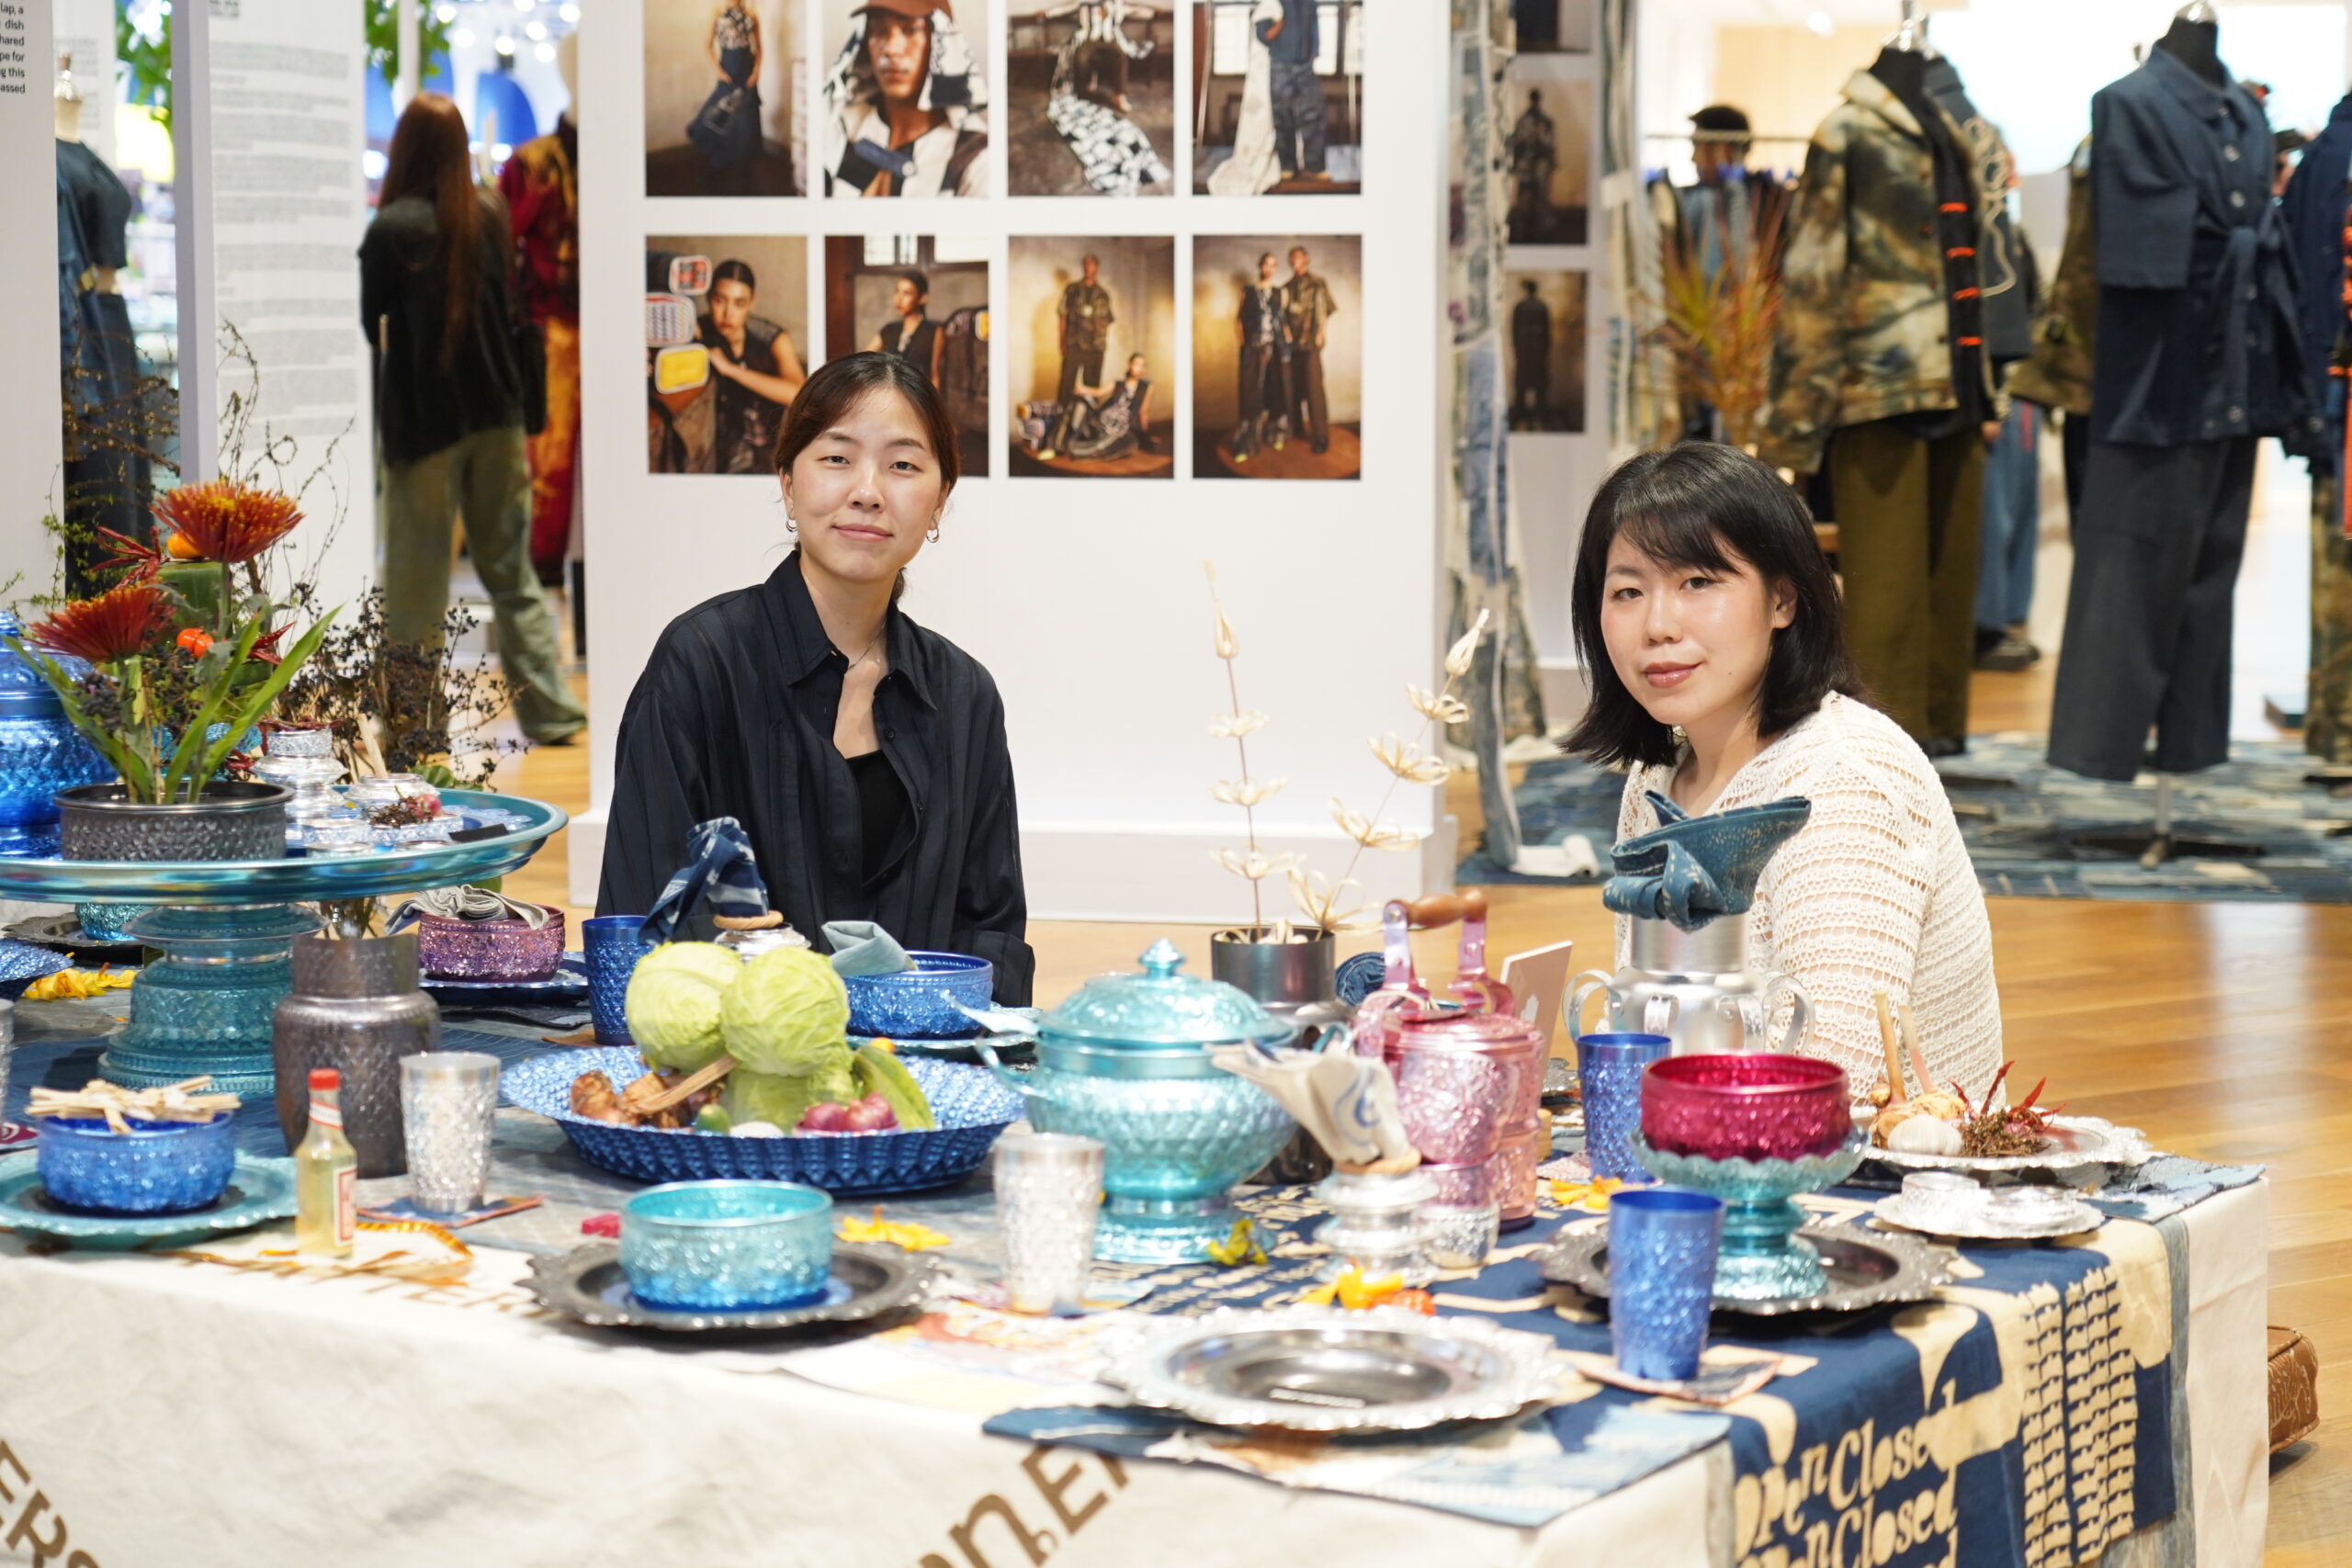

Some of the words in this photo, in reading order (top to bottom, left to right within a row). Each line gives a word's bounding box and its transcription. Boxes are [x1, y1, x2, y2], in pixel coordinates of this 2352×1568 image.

[18, 6, 24, 15] a
[5, 19, 24, 29] dish
[12, 51, 24, 62] for
[8, 67, 25, 77] this
